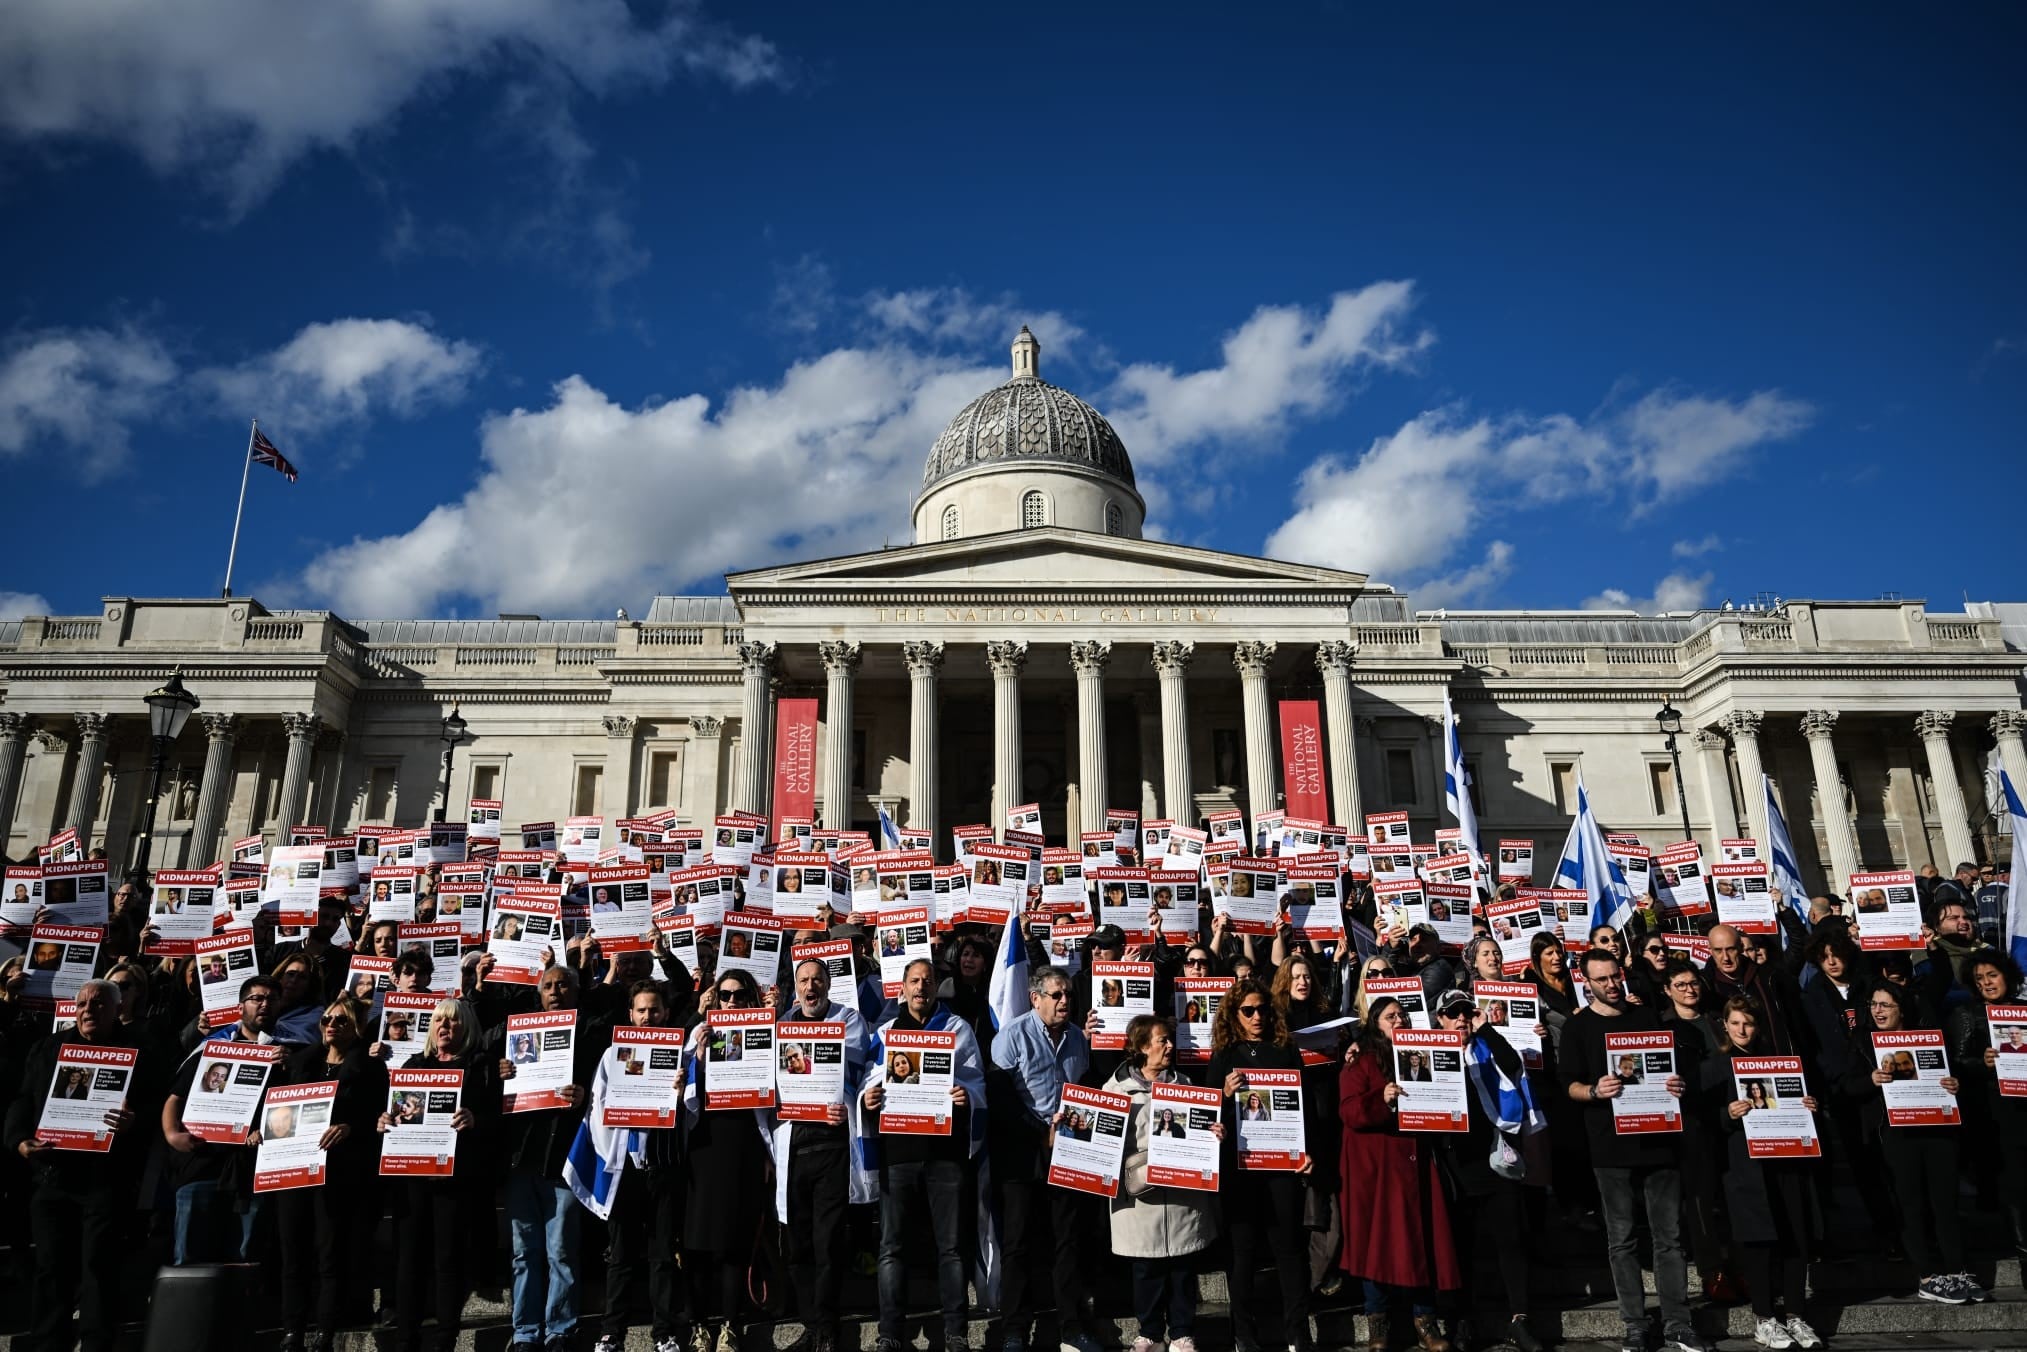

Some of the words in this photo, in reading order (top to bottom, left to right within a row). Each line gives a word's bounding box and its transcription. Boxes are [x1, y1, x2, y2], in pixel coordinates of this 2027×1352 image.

[875, 608, 926, 622] THE
[944, 608, 1082, 622] NATIONAL
[1100, 608, 1220, 622] GALLERY
[786, 722, 799, 792] NATIONAL
[798, 723, 812, 794] GALLERY
[1292, 724, 1308, 794] NATIONAL
[1304, 724, 1320, 794] GALLERY
[1009, 805, 1038, 815] KIDNAPPED
[647, 811, 675, 823] KIDNAPPED
[717, 818, 755, 826] KIDNAPPED
[1368, 814, 1406, 822] KIDNAPPED
[631, 824, 664, 832] KIDNAPPED
[1285, 819, 1321, 829] KIDNAPPED
[51, 830, 76, 845] KIDNAPPED
[1006, 832, 1044, 843] KIDNAPPED
[1437, 830, 1461, 838] KIDNAP
[234, 835, 262, 847] KIDNAPPED
[762, 841, 799, 853] KIDNAPPED
[837, 842, 871, 858] KIDNAPPED
[977, 845, 1028, 858] KIDNAPPED
[1666, 842, 1696, 851] KIDNAPPED
[753, 855, 774, 863] KIDNA
[852, 852, 900, 863] KIDNAPPED
[1299, 853, 1338, 863] KIDNAPPED
[1426, 855, 1468, 868] KIDNAPPED
[1650, 853, 1695, 864] KIDNAPPED
[45, 863, 105, 873] KIDNAPPED
[879, 859, 931, 869] KIDNAPPED
[1232, 859, 1276, 869] KIDNAPPED
[591, 868, 647, 879] KIDNAPPED
[672, 868, 717, 881] KIDNAPPED
[1289, 869, 1334, 877] KIDNAPPED
[1714, 865, 1765, 874] KIDNAPPED
[158, 873, 216, 882] KIDNAPPED
[1852, 874, 1911, 884] KIDNAPPED
[1375, 882, 1420, 891] KIDNAPPED
[1428, 886, 1469, 894] KIDNAPPED
[500, 898, 556, 910] KIDNAPPED
[1488, 899, 1536, 914] KIDNAPPED
[879, 911, 925, 921] KIDNAPPED
[657, 918, 692, 928] NAPPED
[726, 916, 781, 927] KIDNAPPED
[36, 928, 99, 939] KIDNAPPED
[401, 925, 458, 935] KIDNAPPED
[197, 934, 250, 949] KIDNAPPED
[794, 943, 849, 957] KIDNAPPED
[353, 959, 392, 968] KIDNAPP
[1096, 964, 1151, 973] KIDNAPPED
[1178, 980, 1232, 989] KIDNAPPED
[1366, 980, 1419, 990] KIDNAPPED
[1477, 985, 1534, 995] KIDNAPPED
[710, 1012, 772, 1023] KIDNAPPED
[1991, 1009, 2027, 1018] KIDNA
[511, 1014, 573, 1026] KIDNAPPED
[616, 1030, 680, 1041] KIDNAPPED
[780, 1026, 842, 1035] KIDNAPPED
[889, 1034, 952, 1044] KIDNAPPED
[1395, 1033, 1458, 1042] KIDNAPPED
[1609, 1035, 1670, 1046] KIDNAPPED
[1876, 1034, 1940, 1044] KIDNAPPED
[63, 1049, 132, 1062] KIDNAPPED
[208, 1045, 273, 1058] KIDNAPPED
[1736, 1060, 1798, 1070] KIDNAPPED
[394, 1074, 459, 1083] KIDNAPPED
[269, 1085, 334, 1100] KIDNAPPED
[1155, 1087, 1218, 1101] KIDNAPPED
[1066, 1088, 1128, 1108] KIDNAPPED
